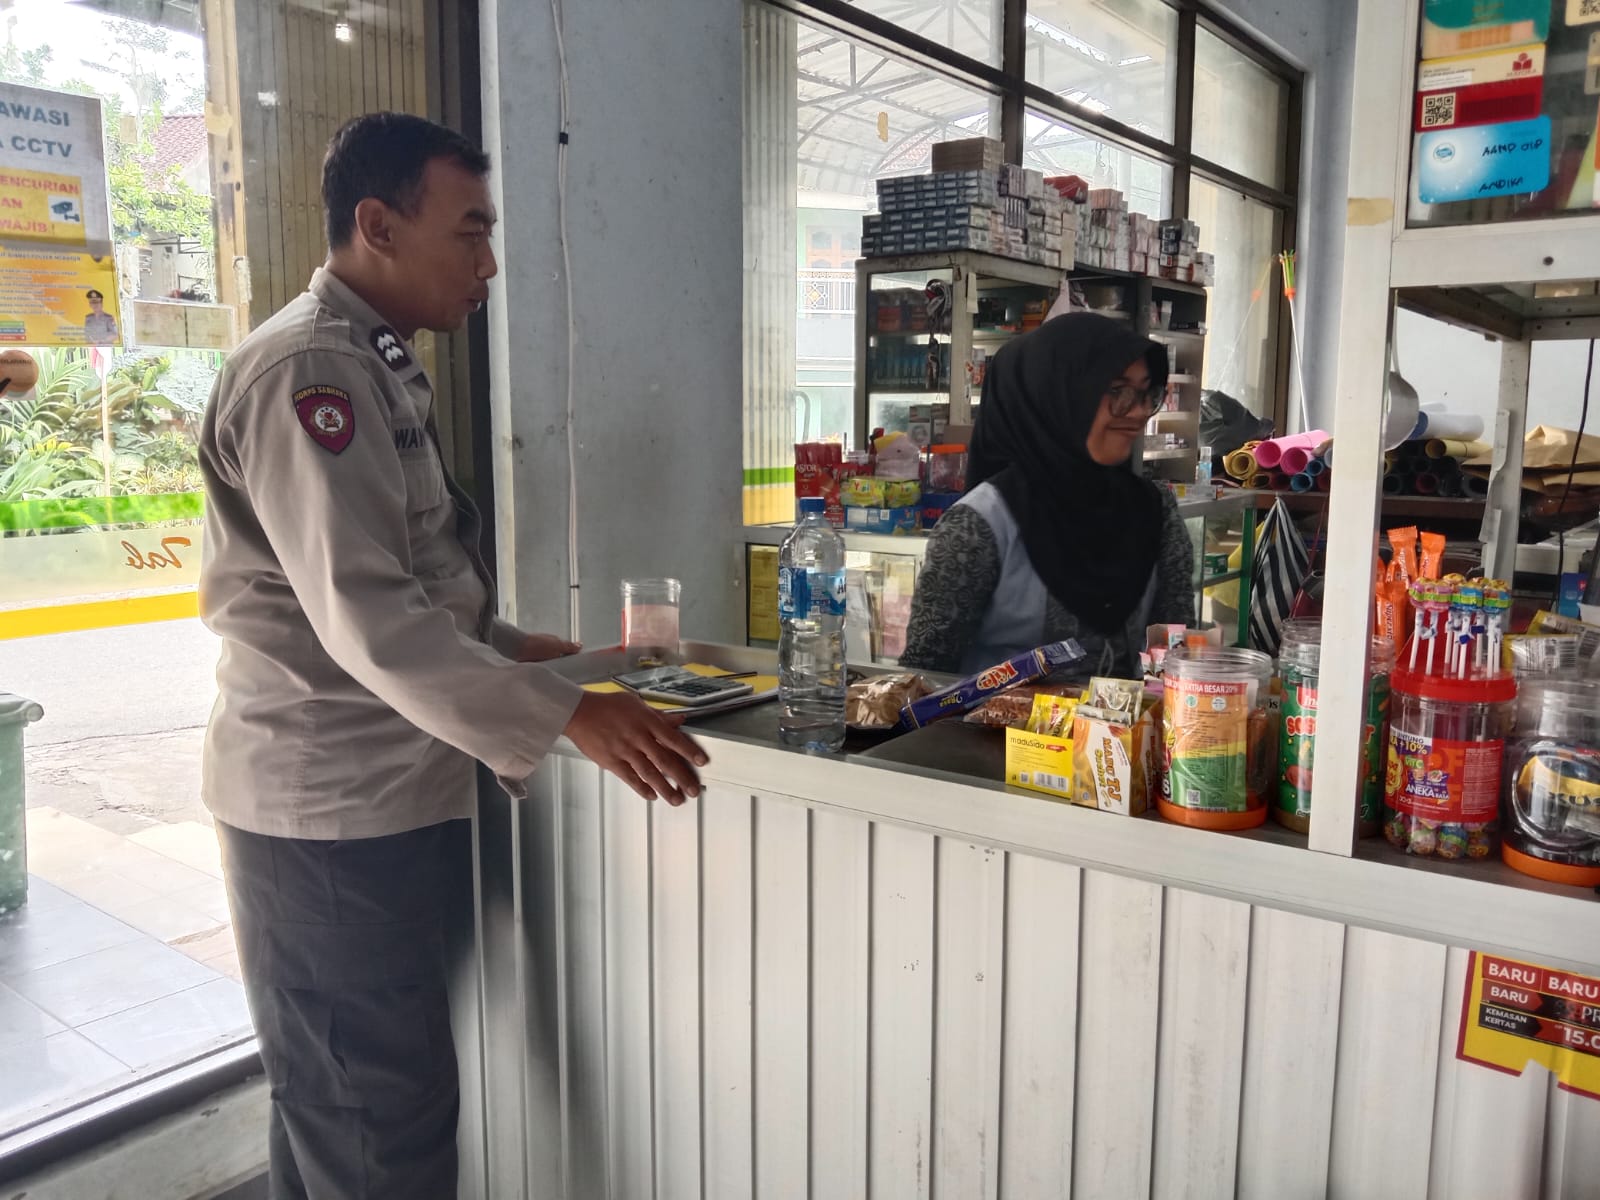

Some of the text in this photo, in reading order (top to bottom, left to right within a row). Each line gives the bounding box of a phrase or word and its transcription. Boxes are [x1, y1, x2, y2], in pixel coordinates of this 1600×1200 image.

[11, 135, 72, 158] CCTV
[1107, 778, 1122, 801] TJ
[1405, 783, 1435, 797] ANEKA
[1488, 963, 1598, 998] BARU BARU
[1490, 986, 1529, 1005] BARU
[1484, 1015, 1516, 1029] KERTAS
[1486, 1007, 1527, 1023] KEMASAN
